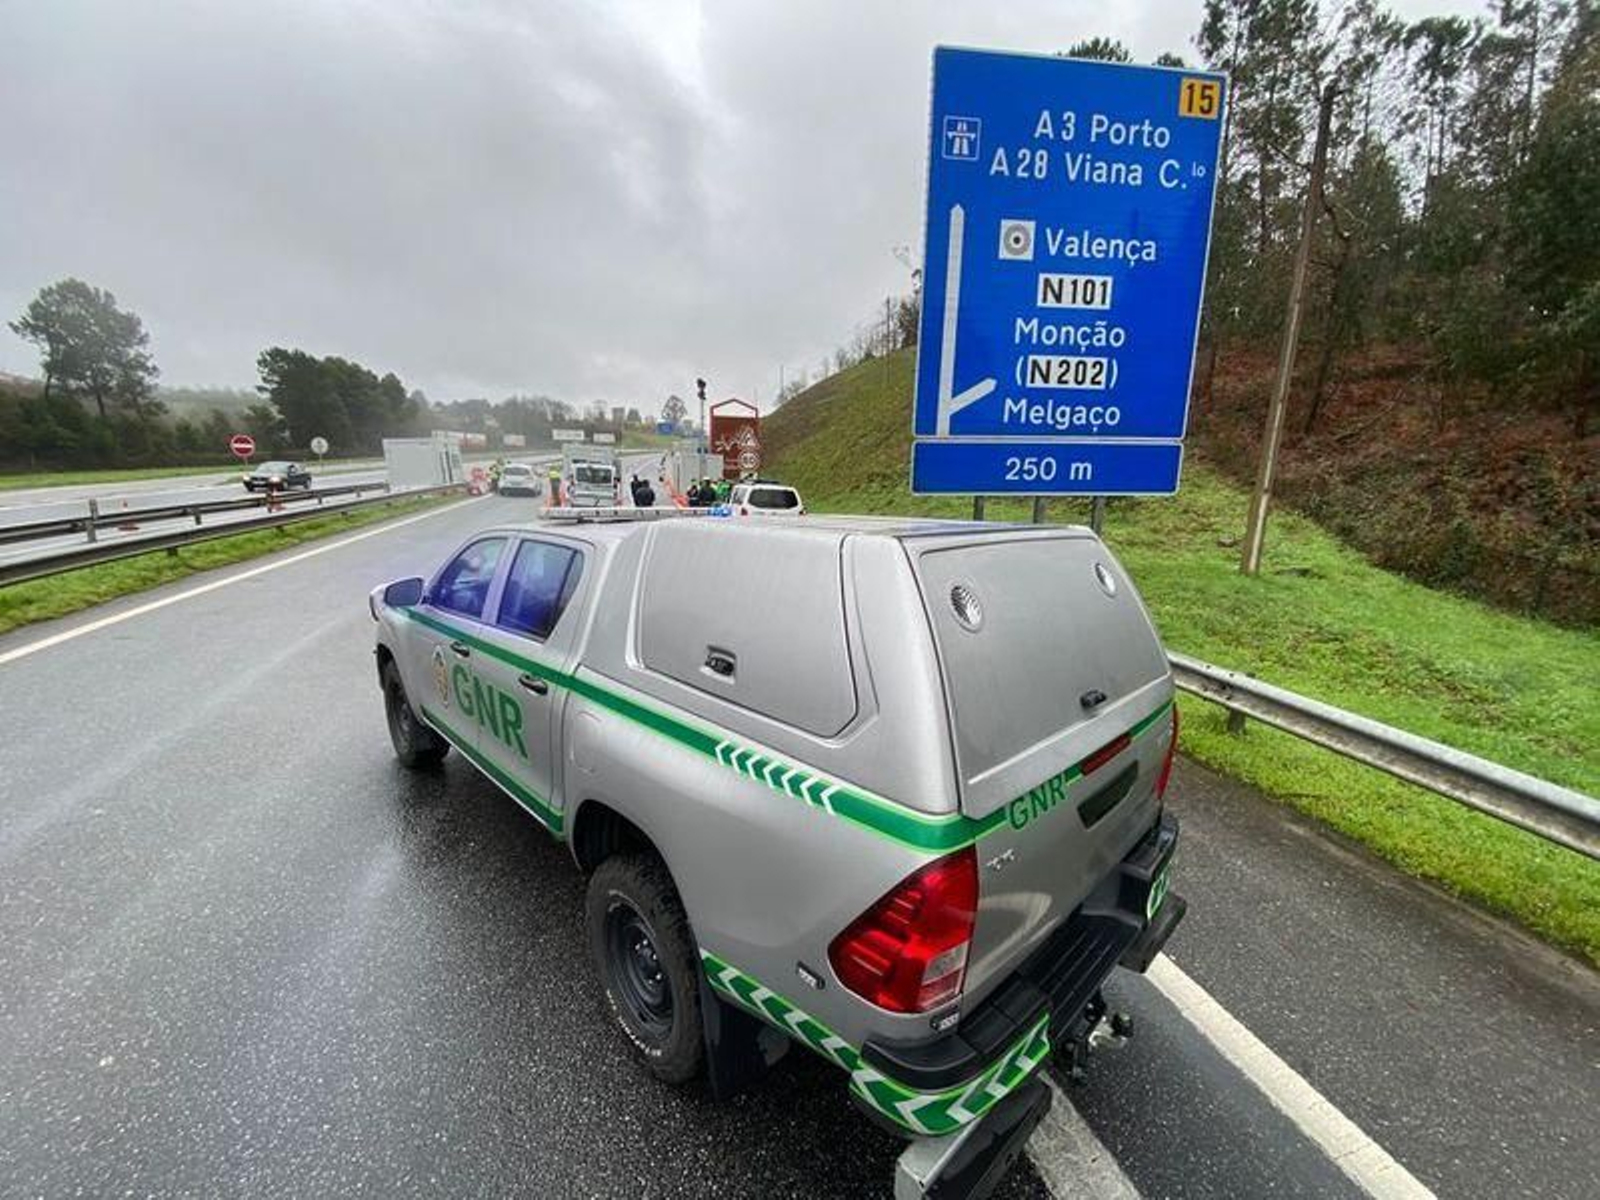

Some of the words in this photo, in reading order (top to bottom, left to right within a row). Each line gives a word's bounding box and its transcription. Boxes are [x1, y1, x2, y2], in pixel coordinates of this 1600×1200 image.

[1185, 82, 1214, 114] 15
[1091, 114, 1170, 148] Porto
[1065, 153, 1143, 186] Viana
[1045, 228, 1156, 266] Valença
[1042, 278, 1109, 305] N101
[1014, 318, 1126, 351] Monção
[1003, 399, 1121, 431] Melgaço
[1005, 457, 1057, 481] 250
[1069, 461, 1092, 480] m
[452, 663, 528, 759] GNR
[1008, 771, 1067, 830] GNR
